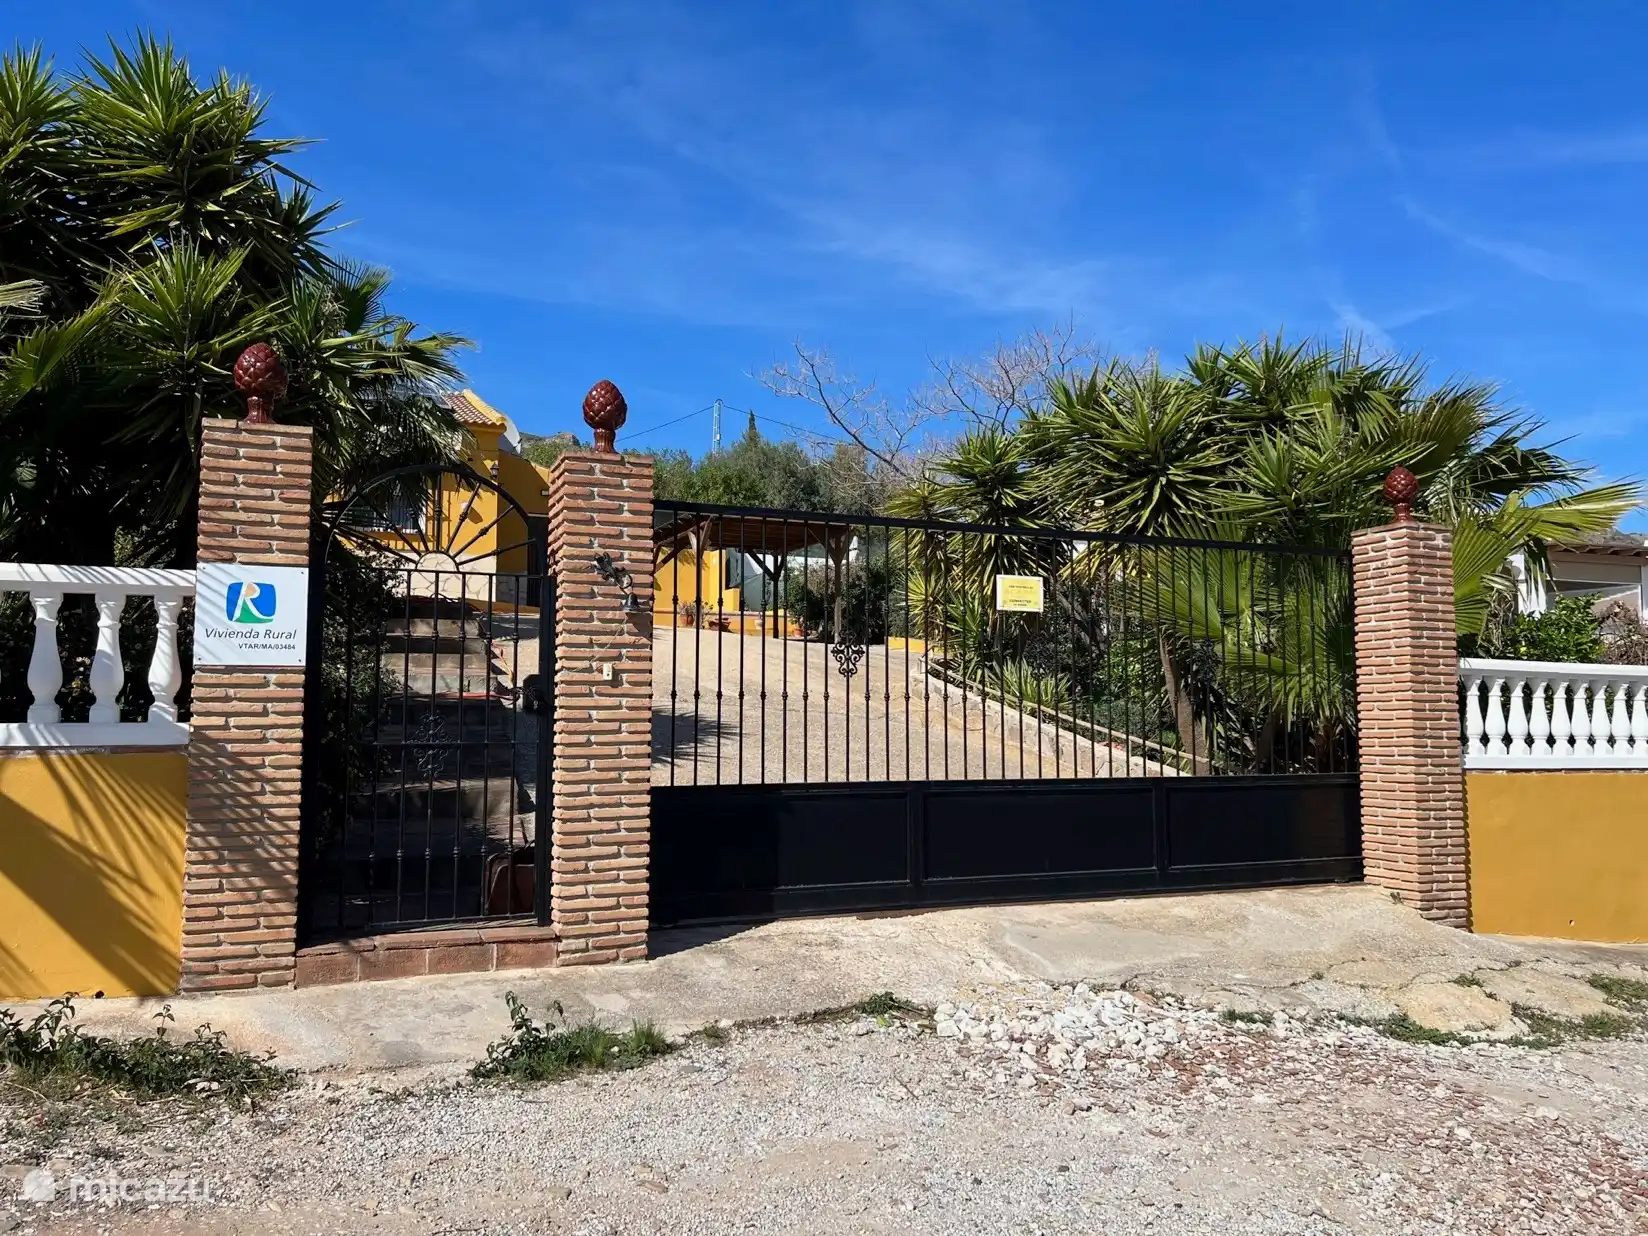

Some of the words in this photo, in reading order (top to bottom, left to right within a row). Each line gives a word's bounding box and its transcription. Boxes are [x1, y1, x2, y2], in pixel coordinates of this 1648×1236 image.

[232, 581, 274, 622] R
[205, 628, 260, 639] Vivienda
[264, 629, 297, 640] Rural
